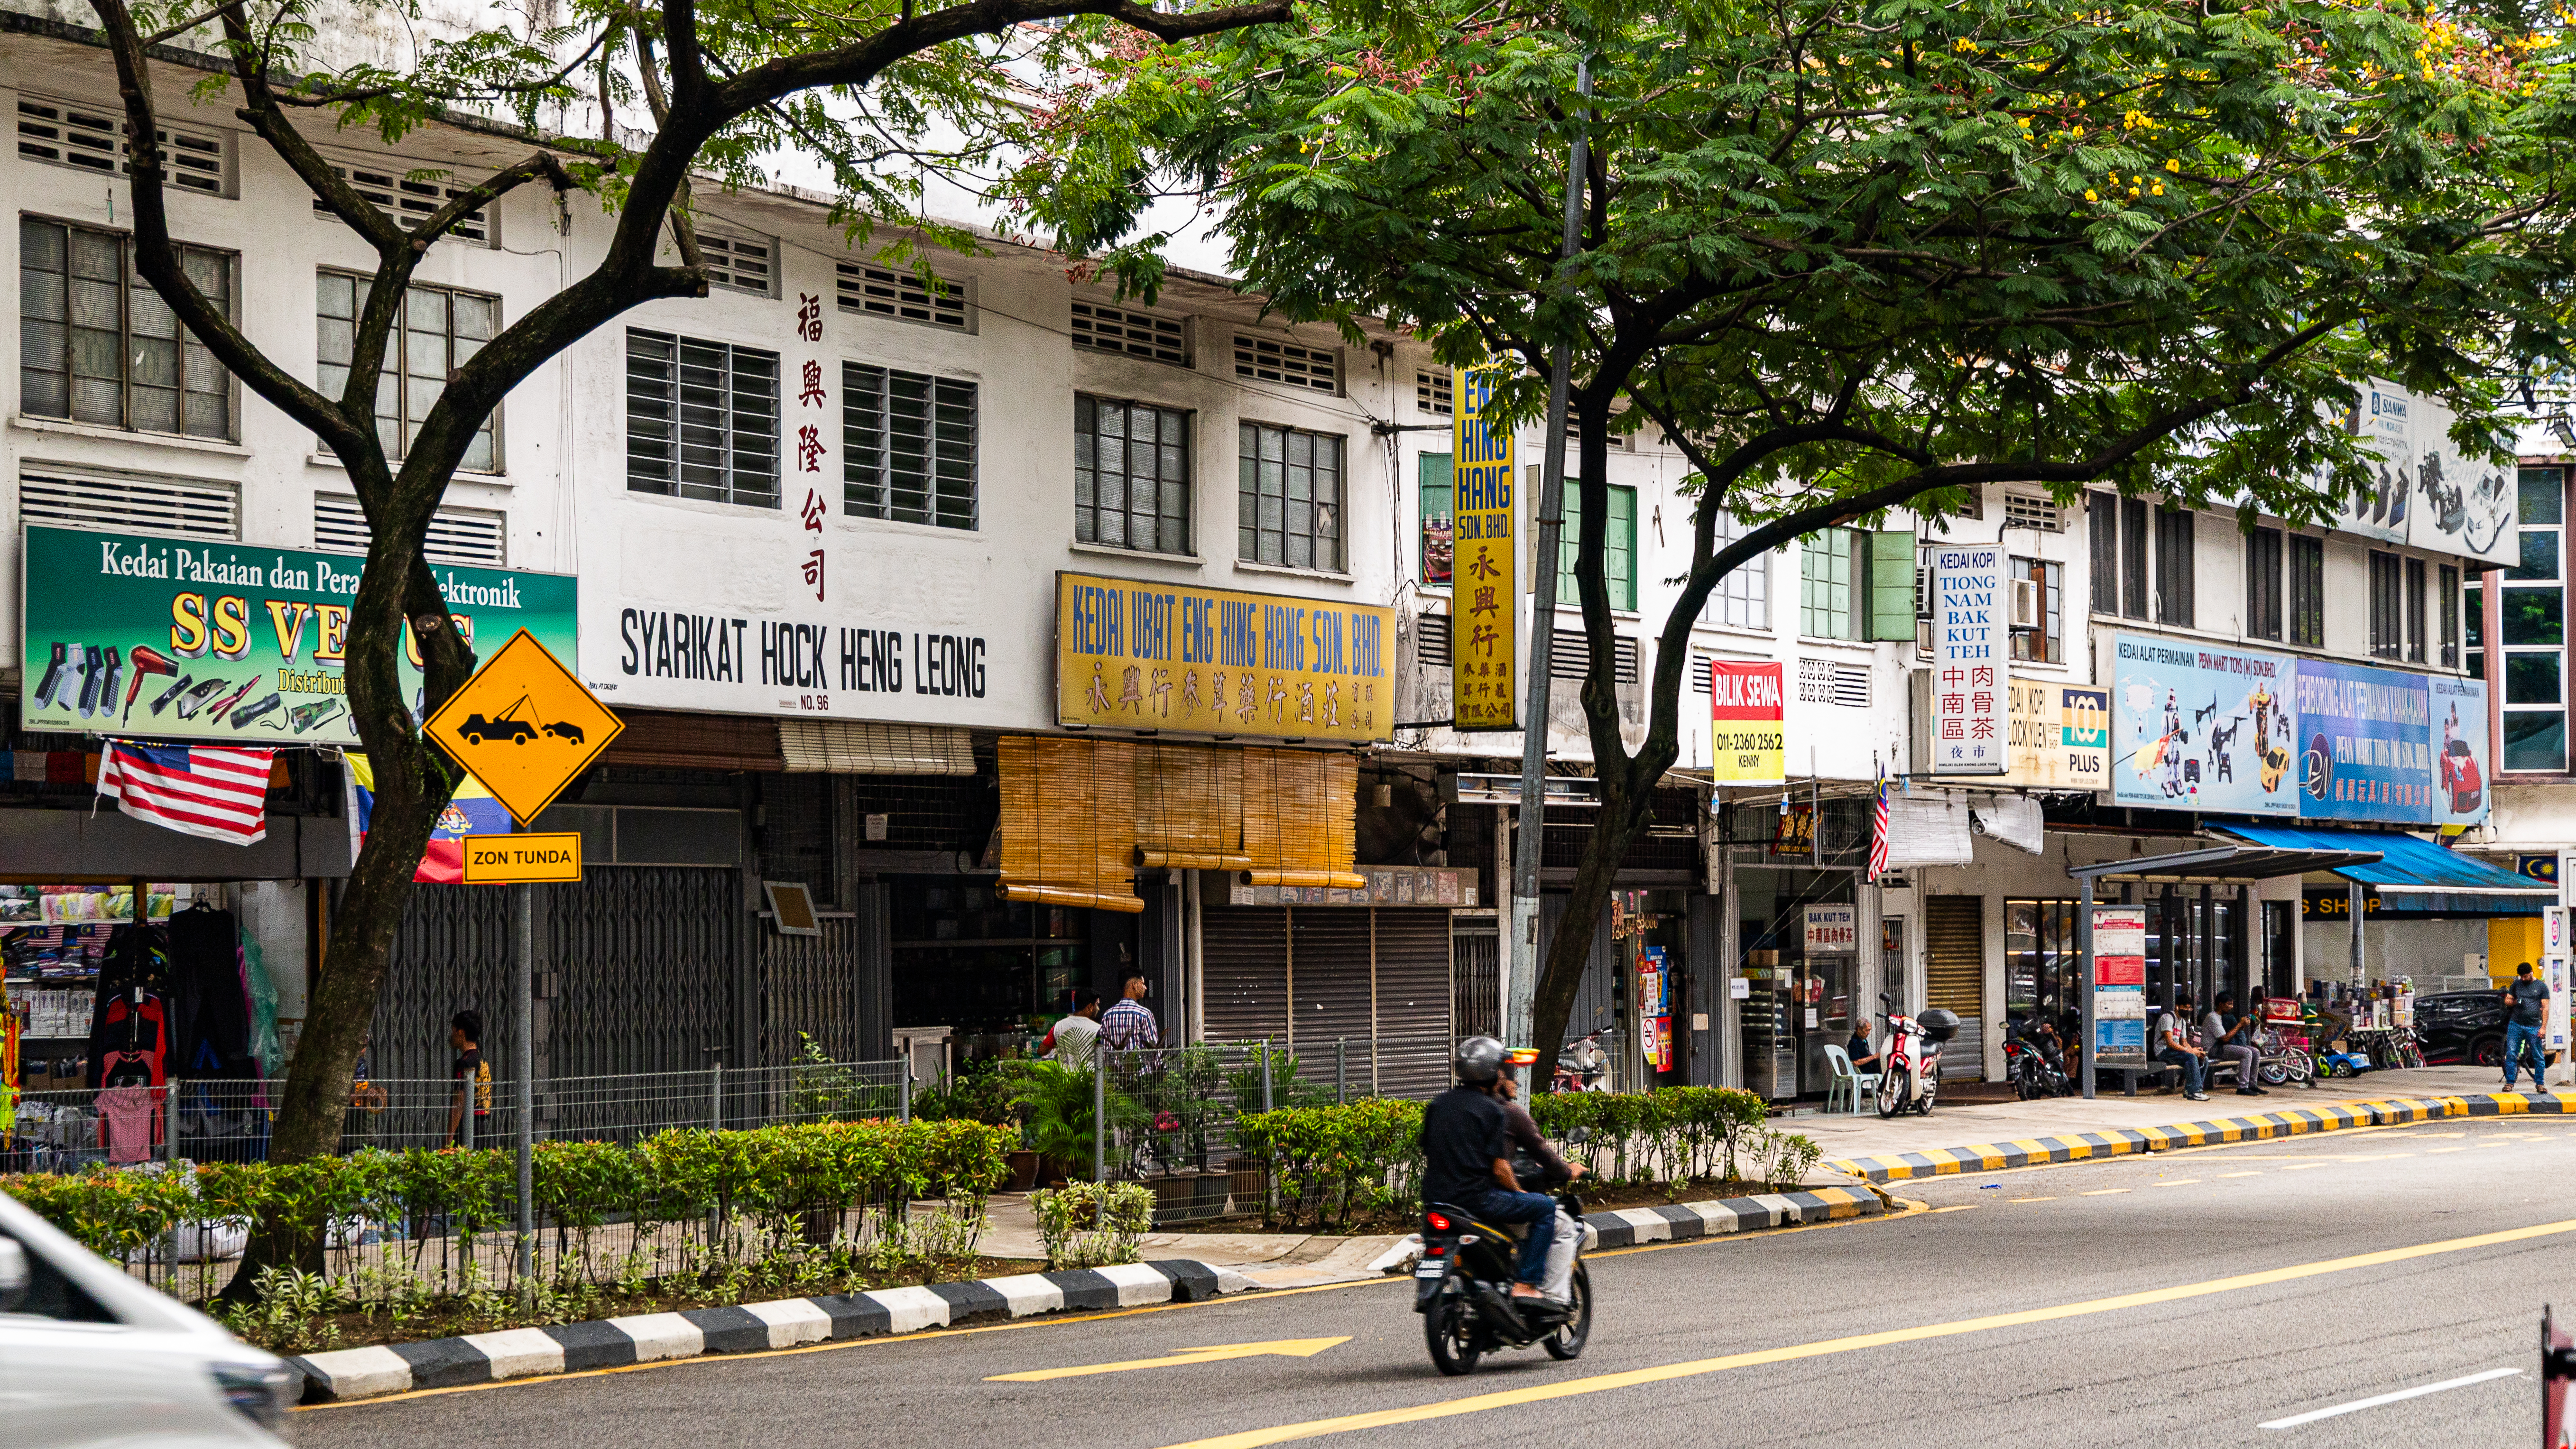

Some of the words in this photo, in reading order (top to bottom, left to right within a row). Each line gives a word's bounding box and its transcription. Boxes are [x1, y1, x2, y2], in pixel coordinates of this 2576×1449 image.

[2383, 399, 2406, 418] SANWA
[797, 292, 827, 602] 福興隆公司
[1459, 465, 1510, 511] HANG
[1459, 515, 1484, 540] SDN.
[1486, 514, 1510, 538] BHD.
[101, 541, 168, 580] Kedai
[175, 548, 263, 588] Pakaian
[270, 556, 309, 591] dan
[1940, 553, 1969, 569] KEDAI
[1972, 553, 1995, 568] KOPI
[1940, 576, 1995, 590] TIONG
[1469, 545, 1500, 657] 永興行
[1944, 593, 1992, 608] NAM
[170, 591, 250, 663] SS
[1948, 610, 1989, 625] BAK
[1073, 585, 1124, 657] KEDAI
[1132, 591, 1174, 661] UBAT
[1183, 596, 1213, 664] ENG
[1220, 600, 1256, 667] HING
[1265, 604, 1304, 671] HANG
[1312, 609, 1348, 674] SDN.
[1352, 613, 1385, 678] BHD.
[1948, 627, 1990, 642] KUT
[621, 608, 747, 683] SYARIKAT
[762, 620, 827, 690] HOCK
[841, 628, 902, 692] HENG
[914, 633, 985, 698] LEONG
[1946, 645, 1990, 659] TEH
[2119, 642, 2138, 660] KEDAI
[2140, 645, 2156, 662] ALAT
[2158, 648, 2194, 667] PERMAINAN
[2199, 652, 2212, 670] PENN
[2214, 654, 2228, 672] MART
[2230, 657, 2242, 674] TOYS
[2244, 657, 2252, 681] (M)
[801, 695, 814, 710] NO.
[817, 695, 828, 710] 96
[1716, 674, 1745, 706] BILIK
[1747, 674, 1781, 707] SEWA
[1942, 666, 1965, 740] 中南區
[1971, 665, 1994, 740] 肉骨茶
[2029, 688, 2045, 715] KOPI
[2340, 679, 2355, 718] ALAT
[2069, 695, 2099, 743] 100
[1717, 733, 1755, 750] 011-2360
[1758, 733, 1782, 750] 2562
[2029, 721, 2047, 748] YUEN
[1739, 755, 1759, 767] KENNY
[1950, 745, 1985, 758] 夜市
[2069, 754, 2100, 773] PLUS
[2336, 736, 2354, 764] PENN
[2355, 737, 2372, 765] MART
[2374, 738, 2389, 766] TOYS
[474, 851, 508, 865] ZON
[514, 849, 571, 864] TUNDA
[1809, 913, 1822, 923] BAK
[1824, 913, 1836, 923] KUT
[1838, 912, 1850, 922] TEH
